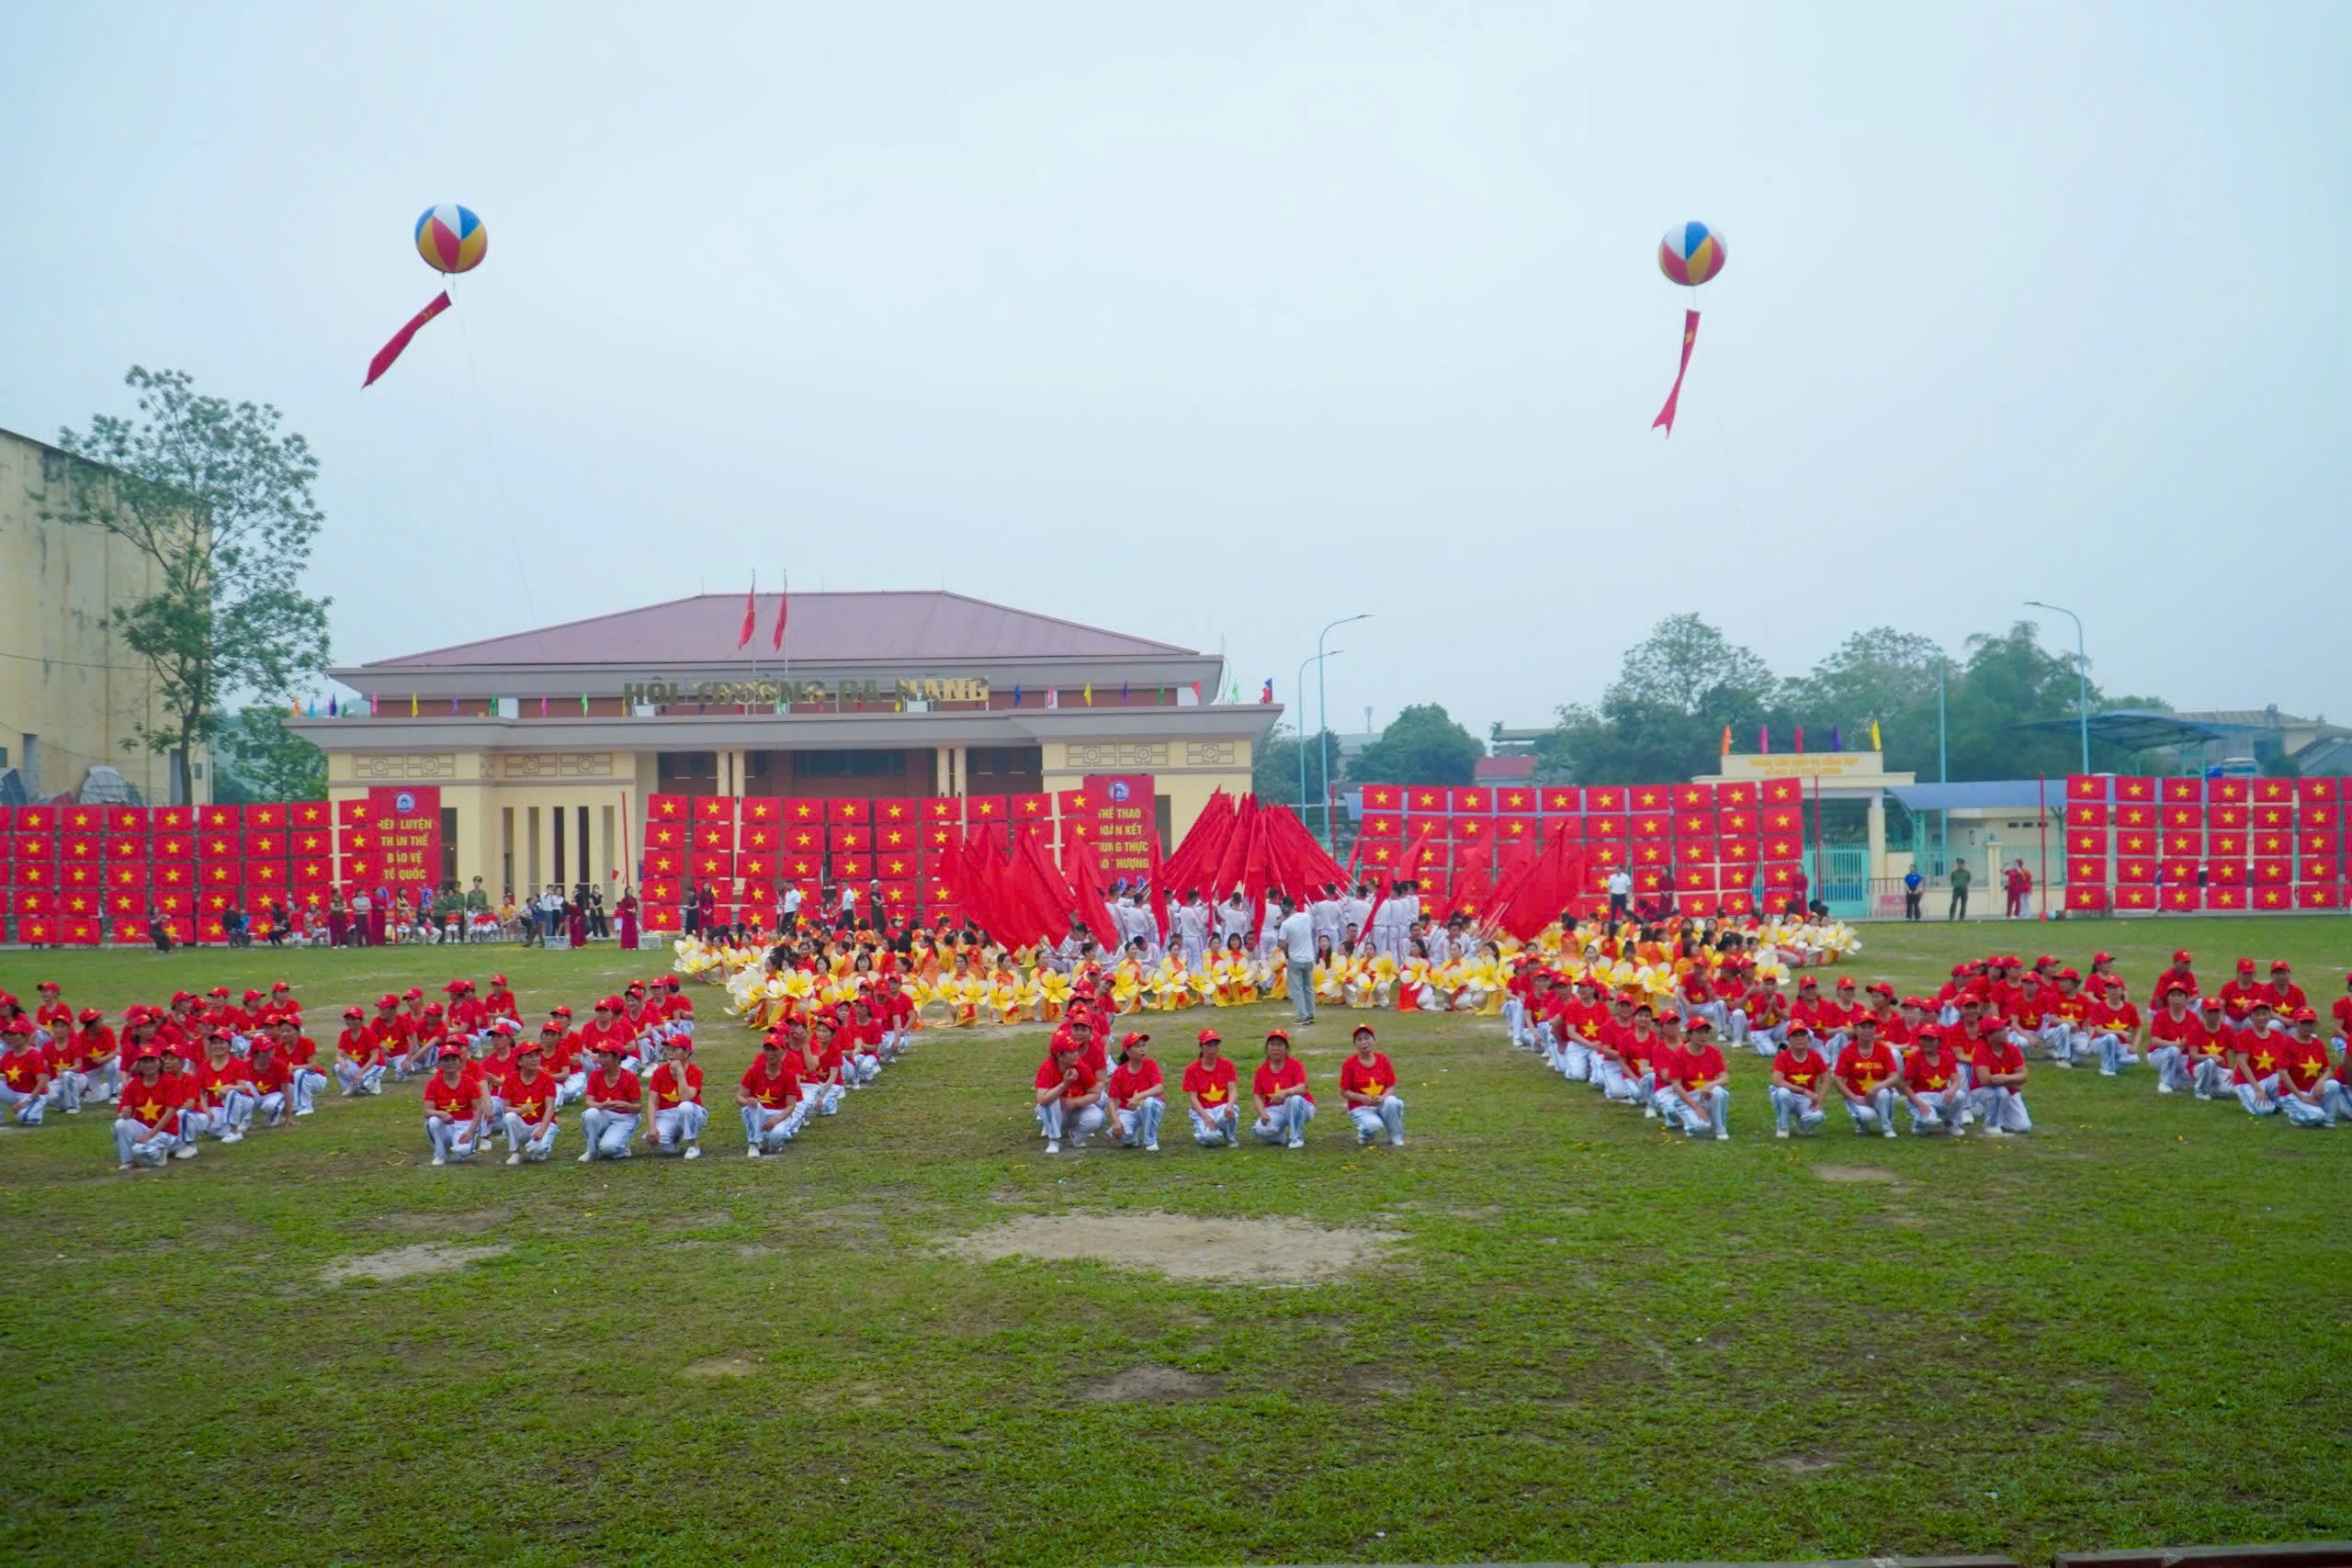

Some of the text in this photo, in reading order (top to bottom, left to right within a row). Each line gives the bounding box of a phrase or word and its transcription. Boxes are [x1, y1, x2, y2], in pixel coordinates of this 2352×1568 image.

[1116, 807, 1141, 819] THAO
[1100, 823, 1122, 836] OÀN
[1100, 841, 1122, 852] UNG
